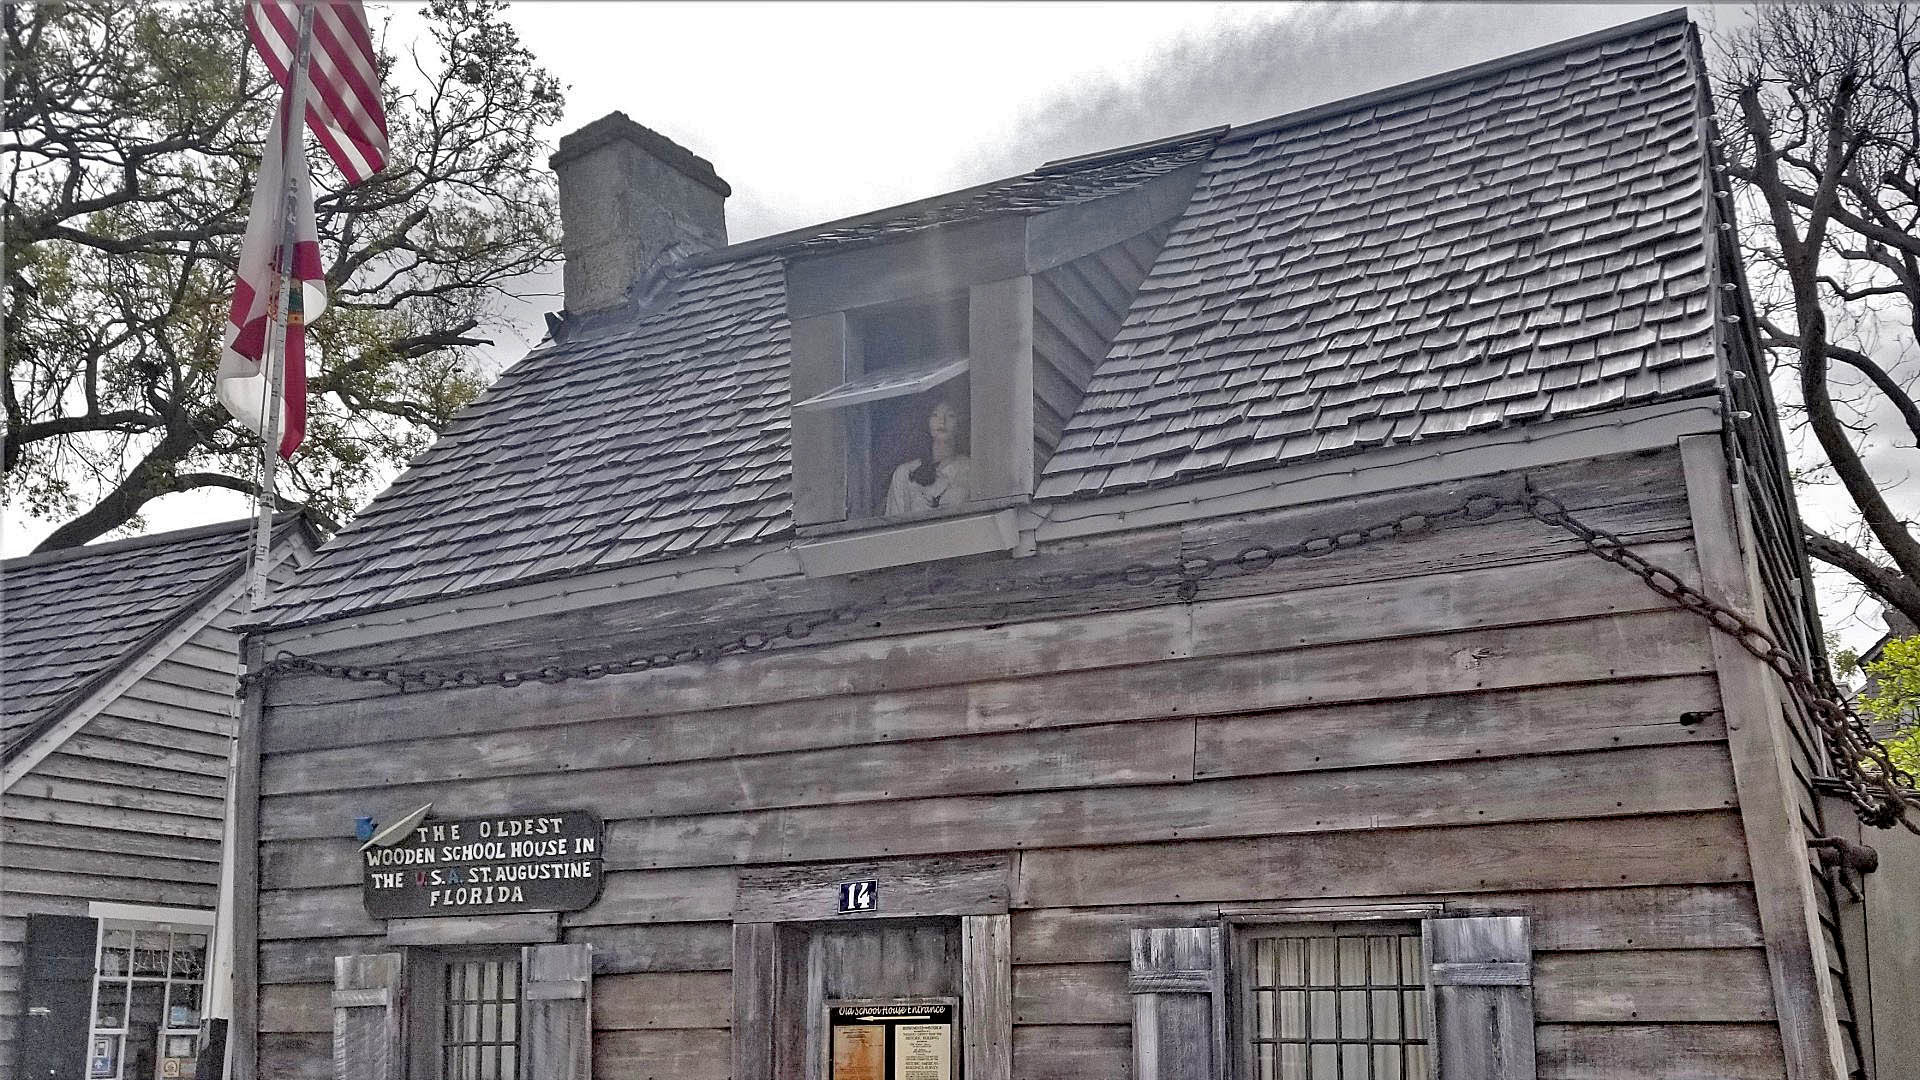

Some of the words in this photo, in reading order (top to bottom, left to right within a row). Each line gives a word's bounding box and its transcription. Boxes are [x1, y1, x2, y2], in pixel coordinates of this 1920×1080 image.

[417, 824, 461, 843] THE
[479, 818, 563, 838] OLDEST
[366, 847, 436, 867] WOODEN
[441, 842, 506, 862] SCHOOL
[511, 839, 567, 858] HOUSE
[574, 837, 595, 854] IN
[371, 872, 404, 889] THE
[495, 862, 592, 881] AUGUSTINE
[429, 886, 524, 907] FLORIDA
[847, 882, 870, 910] 14
[881, 1004, 907, 1015] House
